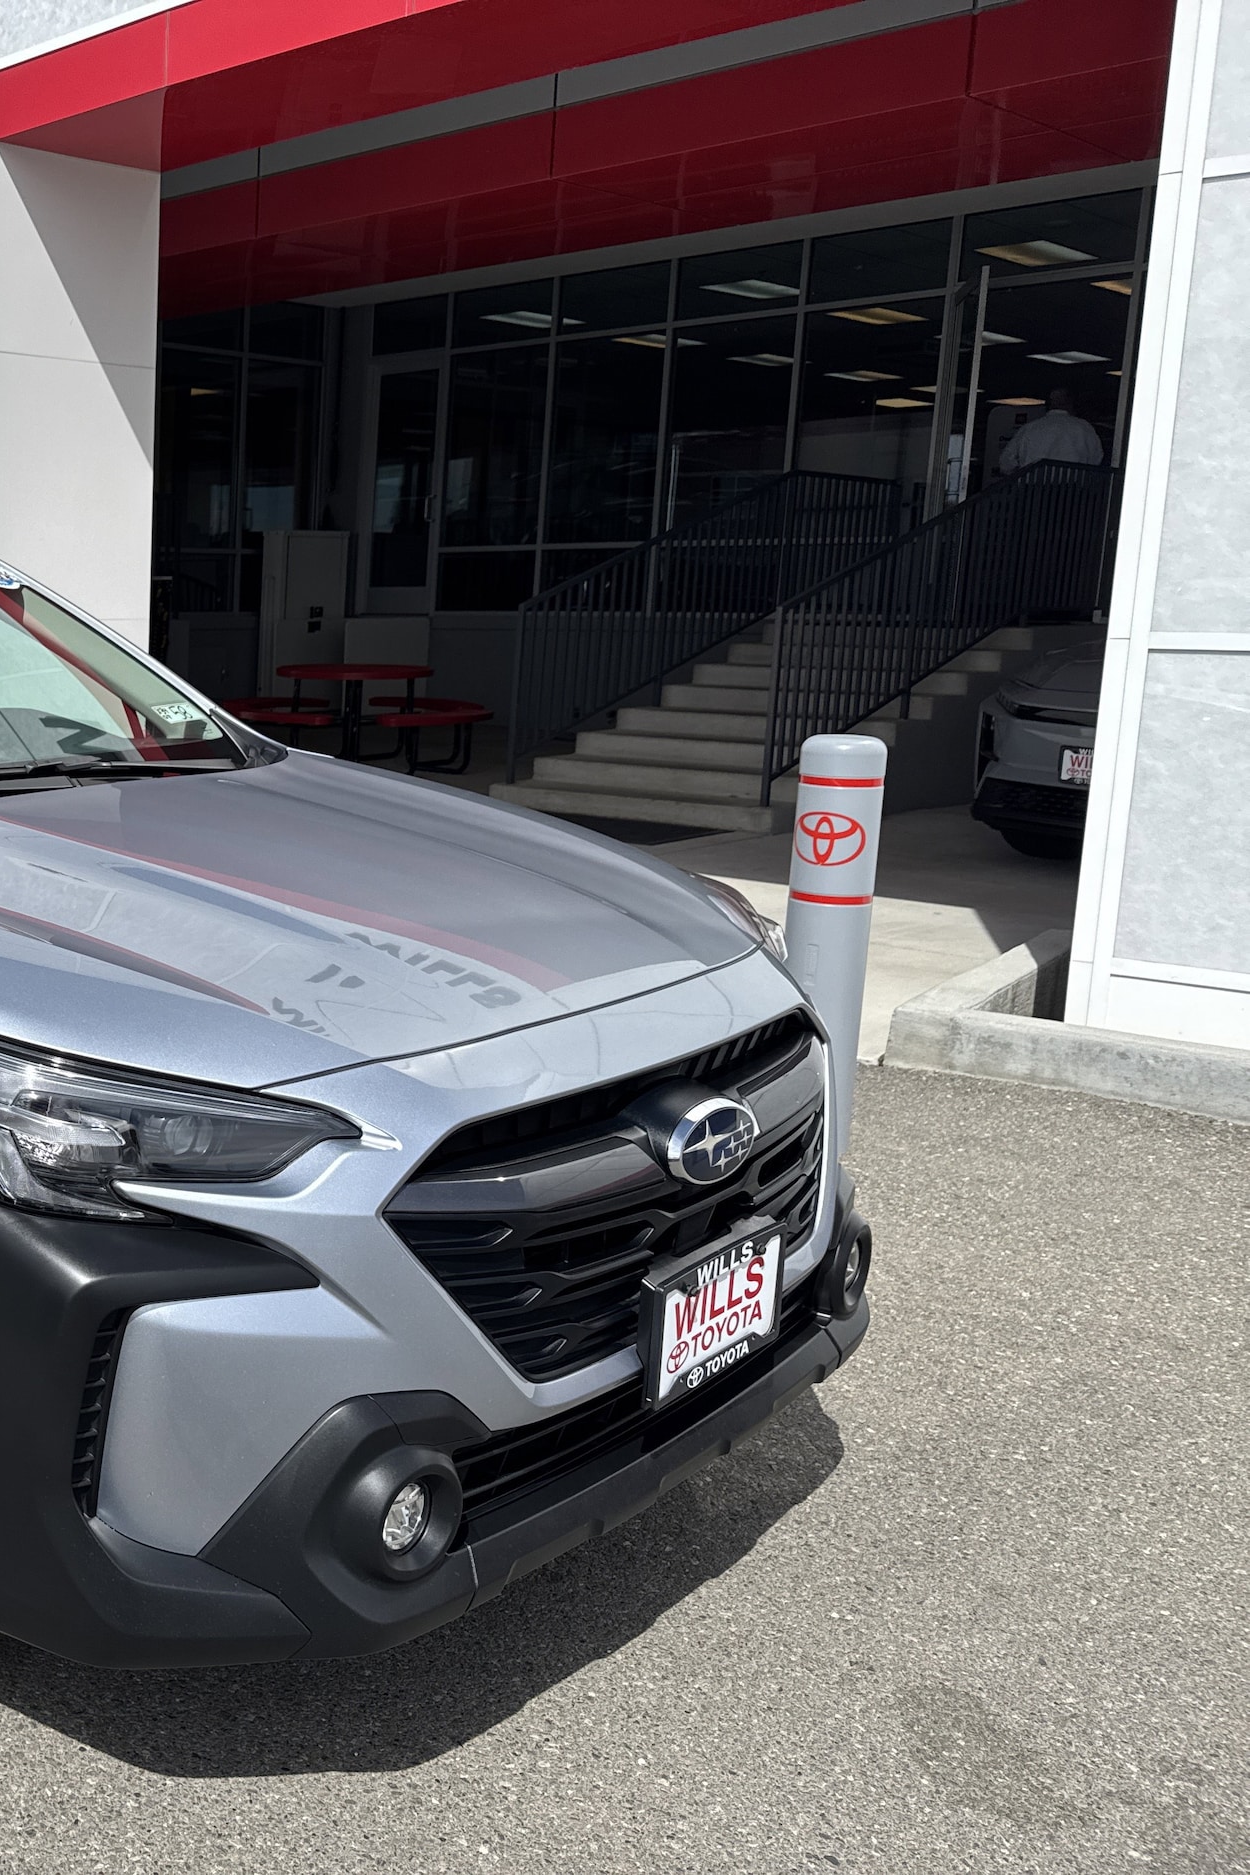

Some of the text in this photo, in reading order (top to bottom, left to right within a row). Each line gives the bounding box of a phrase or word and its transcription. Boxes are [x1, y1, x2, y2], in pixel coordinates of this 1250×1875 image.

[697, 1241, 753, 1286] WILLS
[675, 1257, 764, 1340] WILLS
[692, 1300, 762, 1357] TOYOTA
[705, 1341, 749, 1376] TOYOTA
